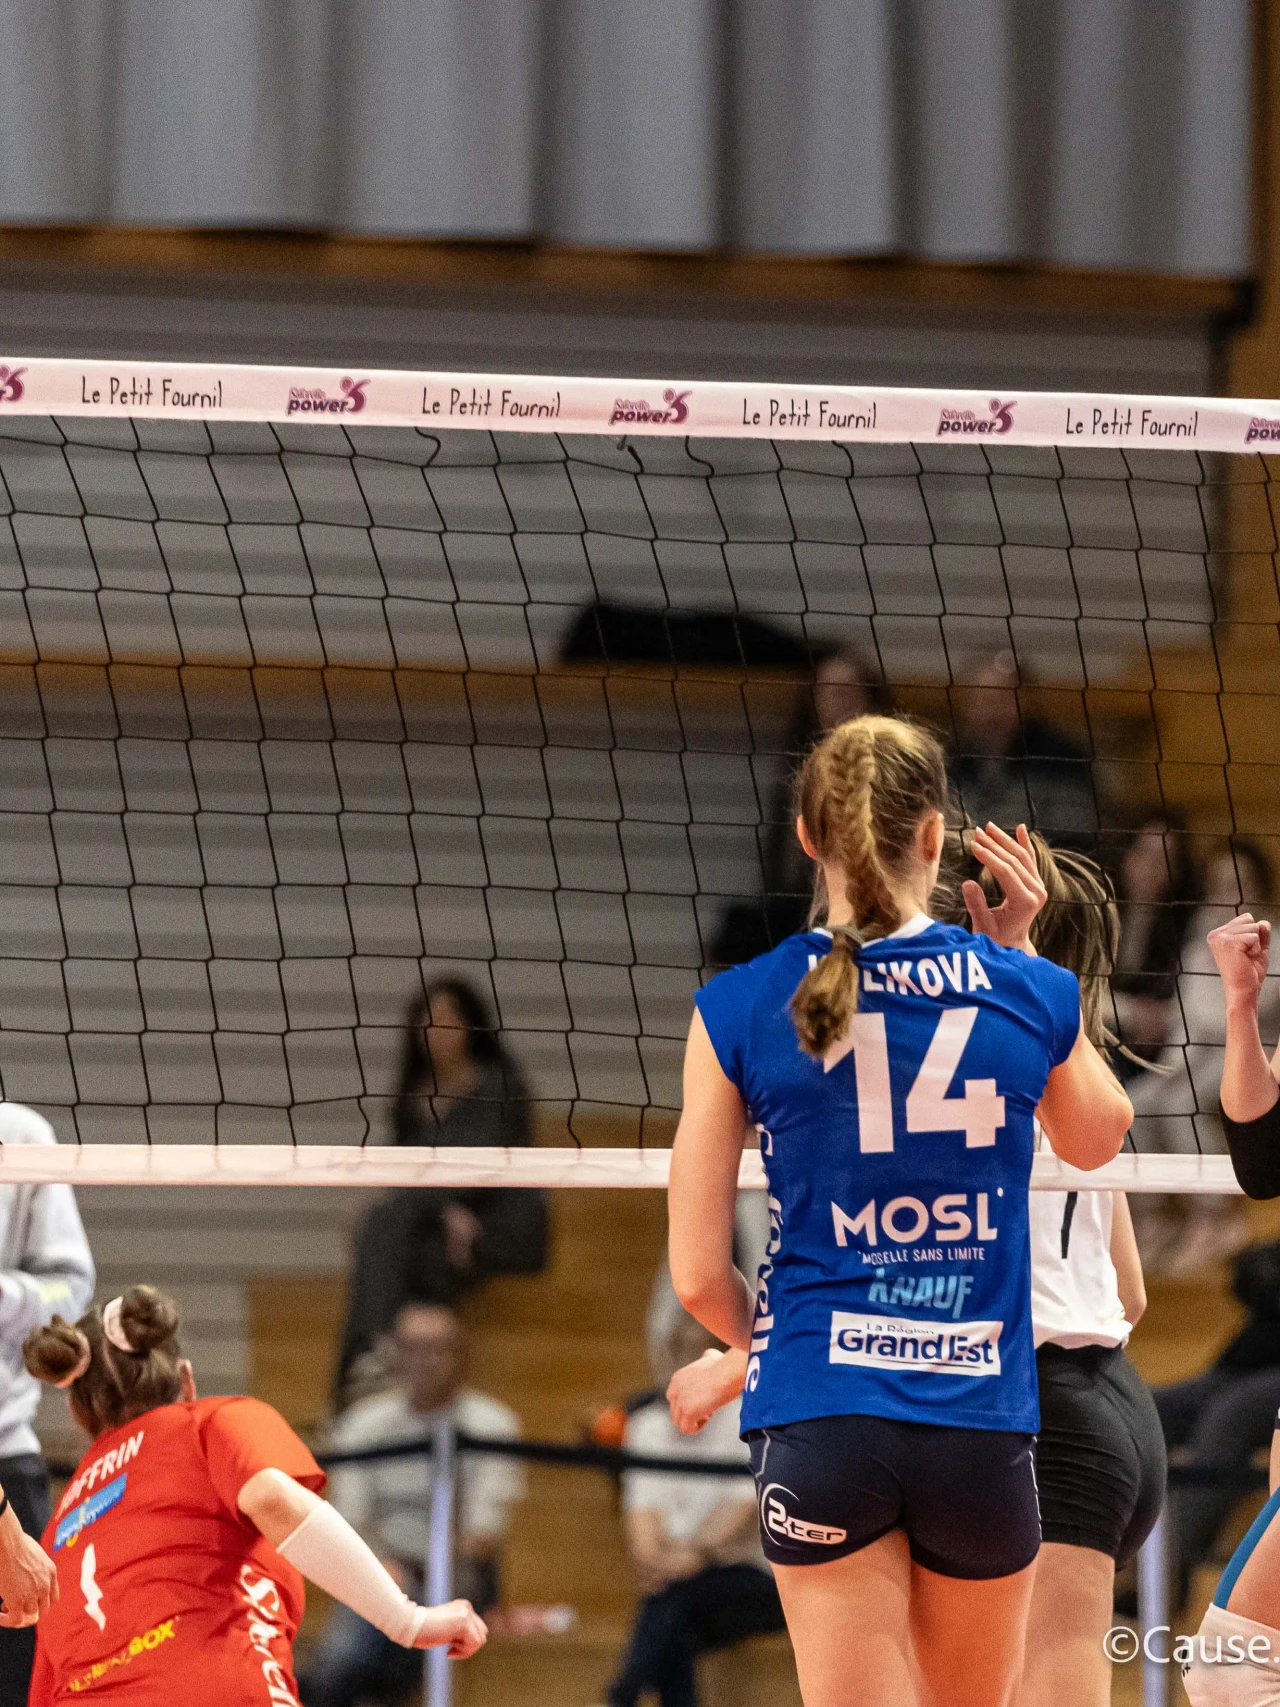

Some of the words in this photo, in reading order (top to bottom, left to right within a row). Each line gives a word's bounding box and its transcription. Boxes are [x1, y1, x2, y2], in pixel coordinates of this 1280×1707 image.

[81, 375, 100, 404] Le
[110, 376, 153, 406] Petit
[162, 378, 223, 408] Fournil
[422, 387, 440, 415] Le
[450, 388, 492, 416] Petit
[500, 390, 560, 418] Fournil
[742, 398, 760, 426] Le
[769, 398, 810, 426] Petit
[819, 401, 877, 429] Fournil
[1066, 408, 1083, 435] Le
[1092, 408, 1133, 436] Petit
[1141, 410, 1198, 438] Fournil
[824, 1007, 1006, 1154] 14
[913, 1248, 943, 1262] SANS
[948, 1247, 986, 1261] LIMITE
[868, 1267, 974, 1319] KNAUF
